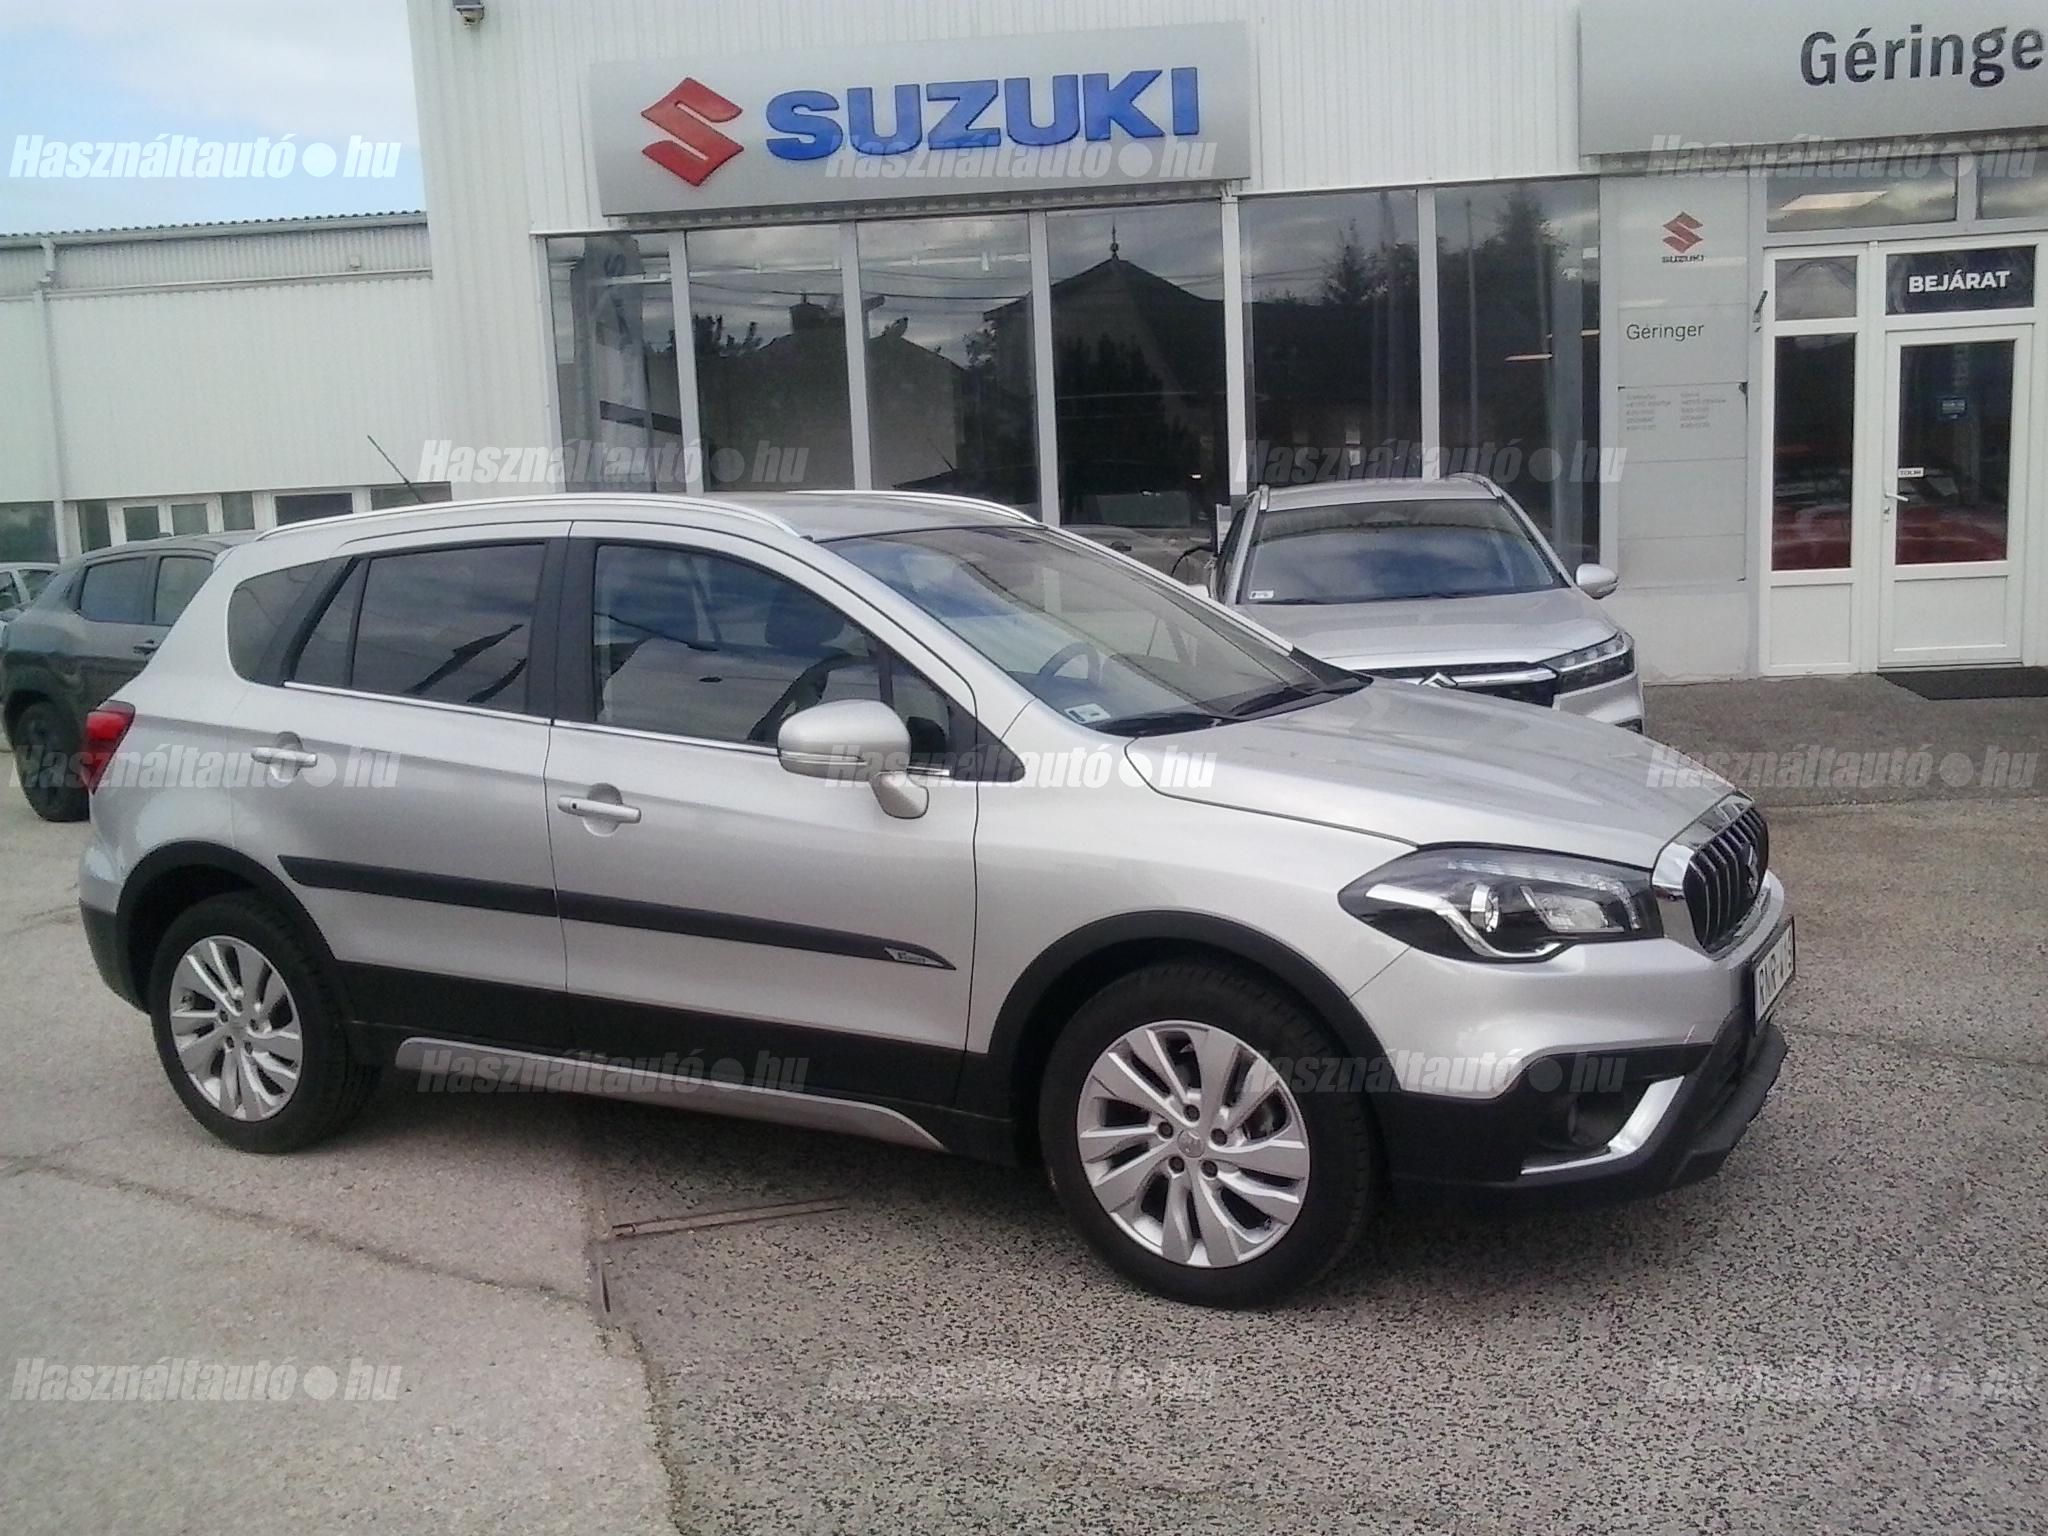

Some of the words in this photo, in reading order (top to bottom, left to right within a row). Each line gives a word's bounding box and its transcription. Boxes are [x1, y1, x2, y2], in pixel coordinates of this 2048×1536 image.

[765, 66, 1200, 161] SUZUKI
[1662, 254, 1704, 264] SUZUKI
[1907, 269, 2011, 294] BEJÁRAT
